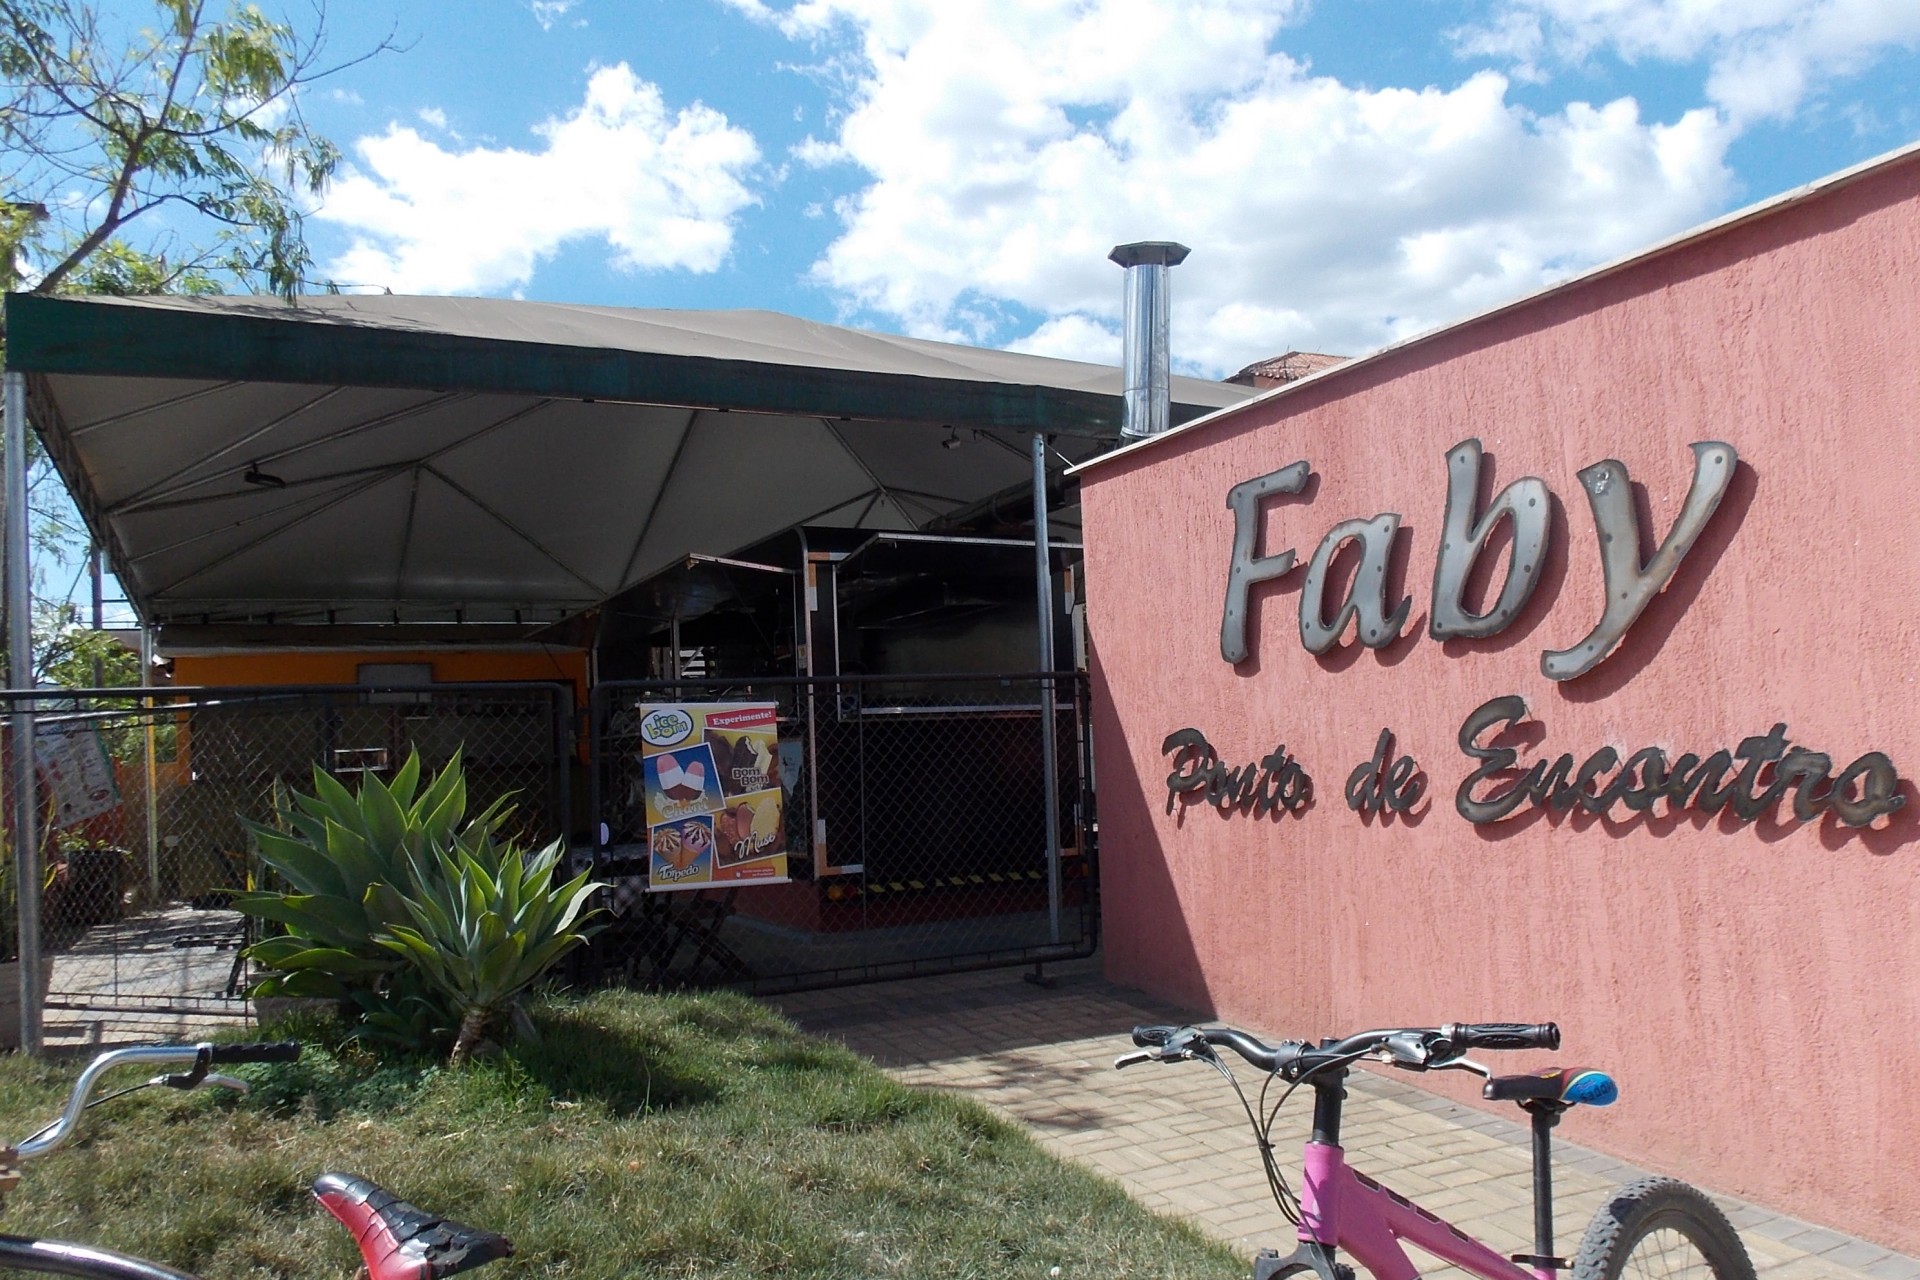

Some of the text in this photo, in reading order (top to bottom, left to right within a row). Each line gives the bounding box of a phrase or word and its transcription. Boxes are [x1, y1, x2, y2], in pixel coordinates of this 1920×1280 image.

[1218, 437, 1740, 682] Faby
[713, 711, 772, 725] Experimente!
[1345, 727, 1420, 812] de
[1455, 694, 1906, 828] Encontro
[734, 832, 775, 859] Must
[659, 865, 699, 881] Torpedo
